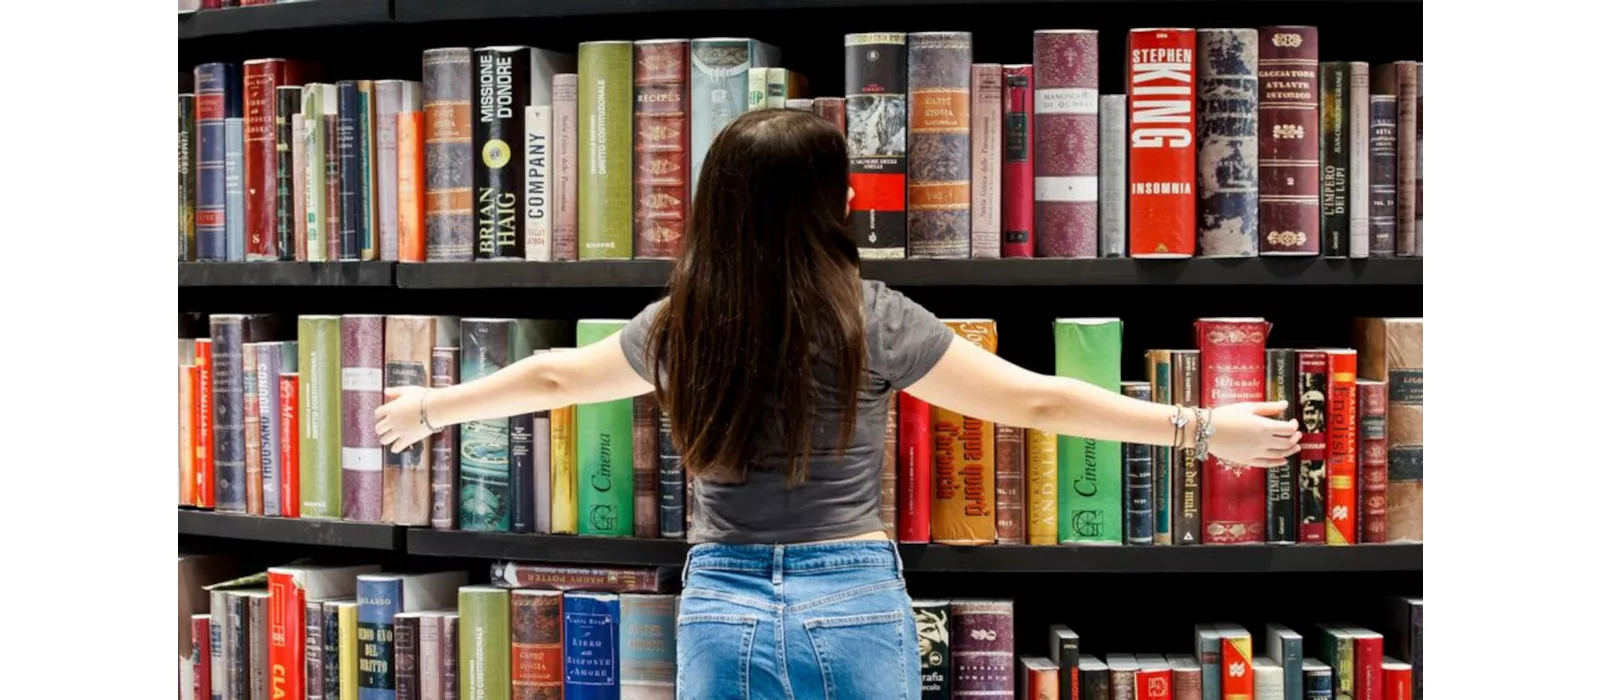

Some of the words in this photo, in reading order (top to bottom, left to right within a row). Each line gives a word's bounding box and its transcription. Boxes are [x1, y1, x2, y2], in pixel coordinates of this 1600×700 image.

[1132, 48, 1192, 63] STEPHEN
[480, 54, 493, 122] MISSIONE
[496, 56, 512, 118] D'ONORE
[1258, 70, 1315, 78] CACCIATORE
[1266, 81, 1309, 89] ATLANTE
[638, 93, 680, 102] RECIPES
[1132, 63, 1192, 148] KING
[528, 133, 545, 218] COMPANY
[1132, 183, 1191, 194] INSOMNIA
[1335, 167, 1345, 192] LUPI
[1324, 165, 1335, 215] L'IMPERO
[1335, 196, 1345, 214] DEI
[479, 187, 494, 253] BRIAN
[496, 192, 516, 247] HAIG
[1330, 386, 1349, 464] English
[1347, 386, 1356, 463] MACMILLAN
[260, 416, 273, 480] THOUSAND
[934, 421, 962, 501] d'arancia
[592, 433, 612, 493] Cinema
[1280, 465, 1290, 478] LU
[958, 464, 992, 517] quarti
[1184, 471, 1197, 487] del
[1280, 480, 1290, 500] DEI
[1184, 491, 1197, 519] male
[528, 574, 566, 582] POTTER
[571, 575, 605, 584] HARRY
[572, 638, 602, 647] LIBRO
